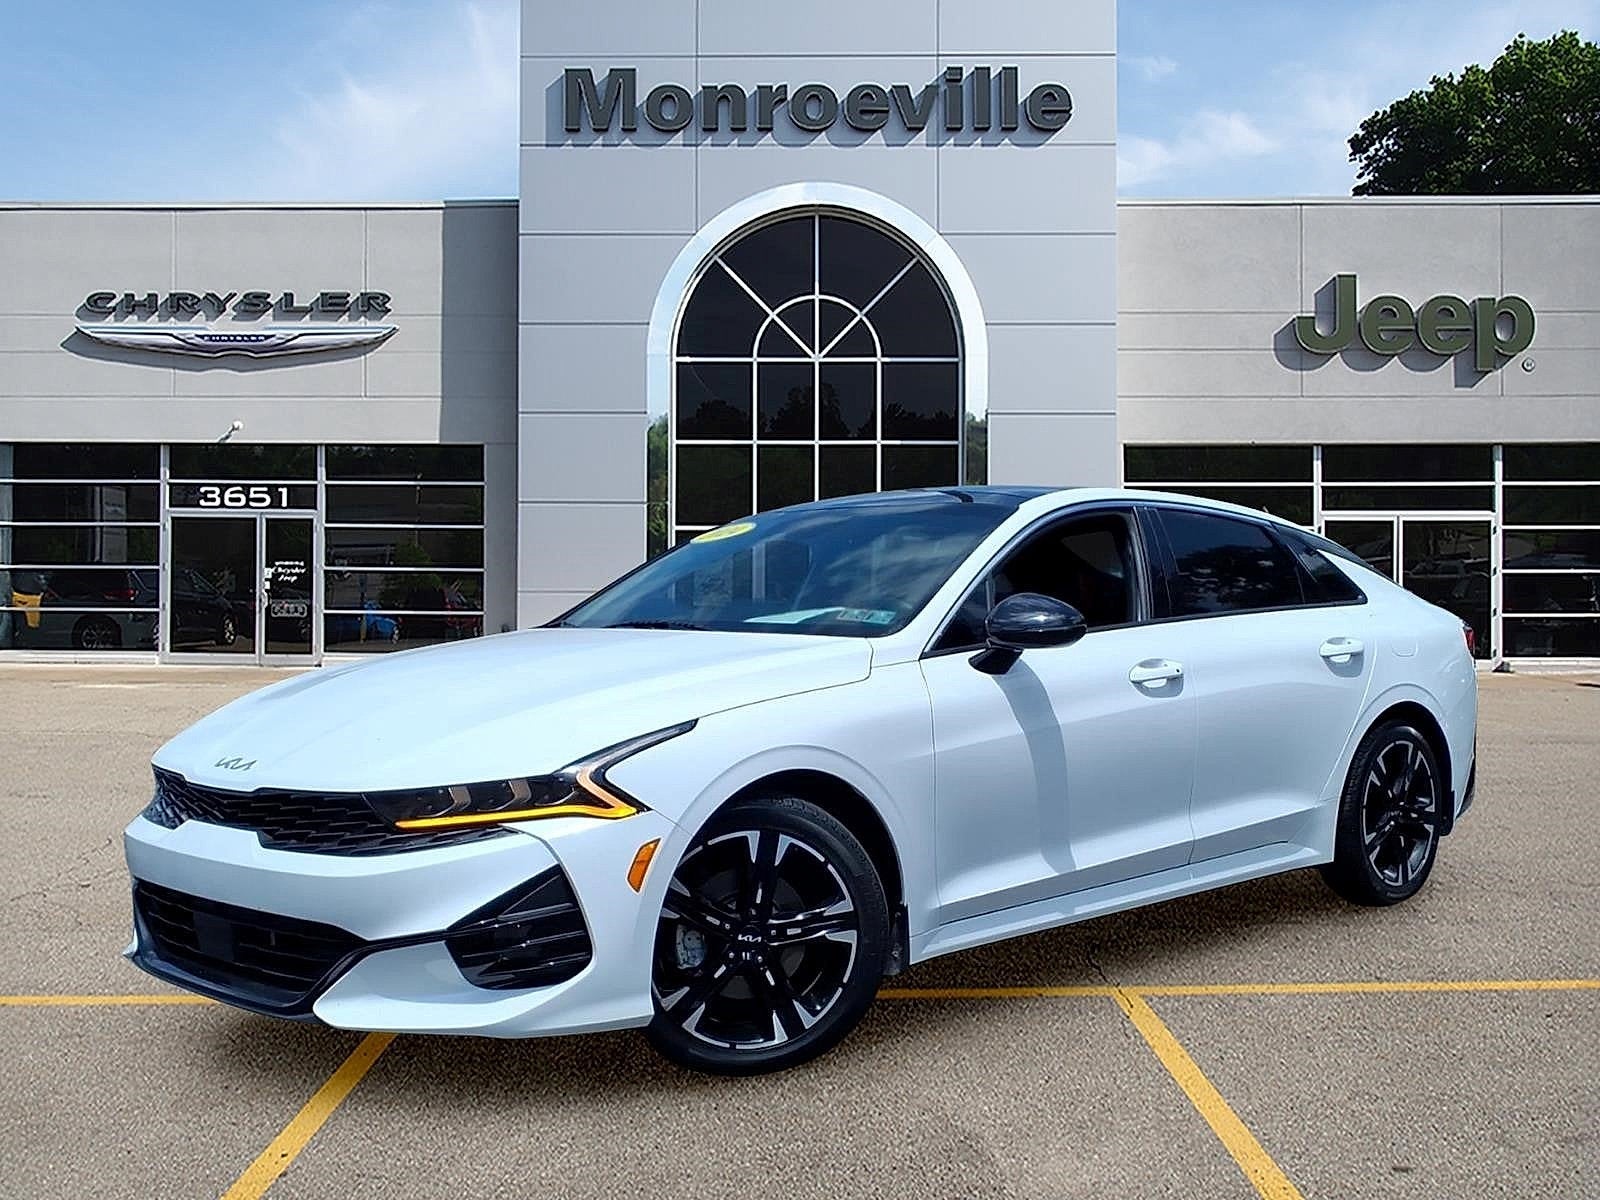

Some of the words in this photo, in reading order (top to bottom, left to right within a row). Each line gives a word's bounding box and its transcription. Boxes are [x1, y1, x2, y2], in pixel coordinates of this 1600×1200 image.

[563, 66, 1074, 133] Monroeville
[83, 291, 393, 315] CHRYSLER
[1295, 273, 1537, 372] Jeep
[199, 486, 288, 508] 3651
